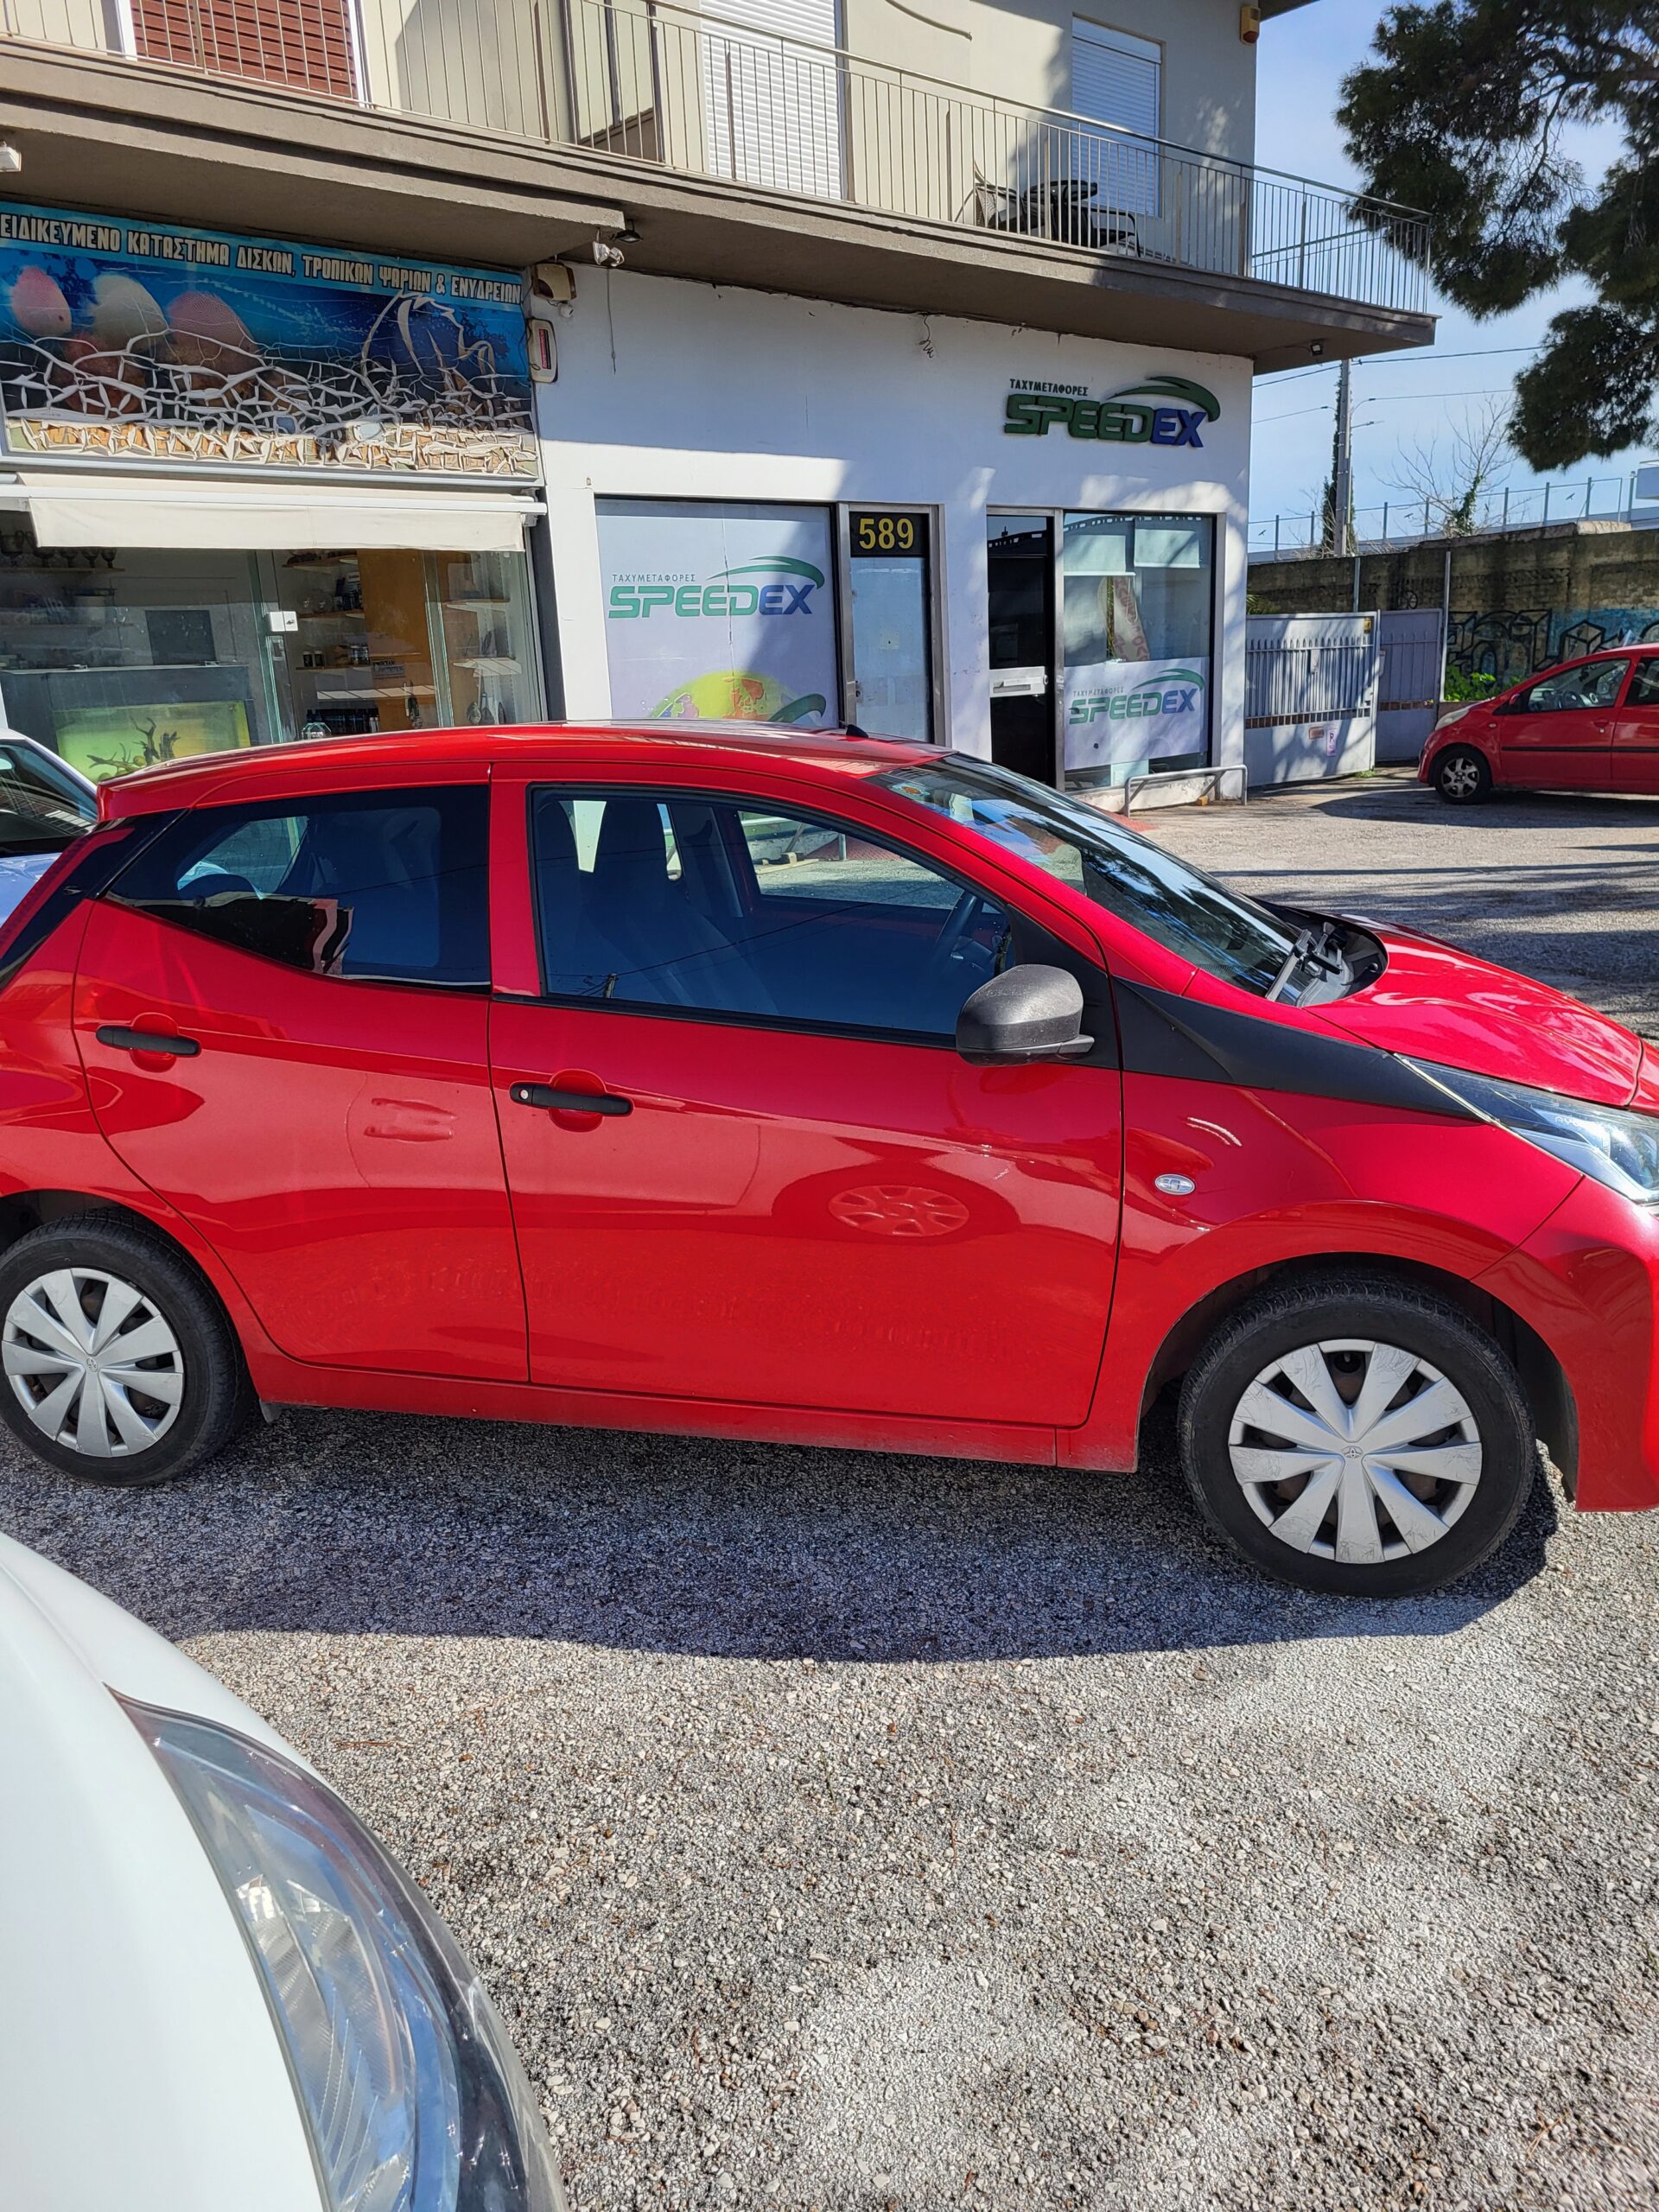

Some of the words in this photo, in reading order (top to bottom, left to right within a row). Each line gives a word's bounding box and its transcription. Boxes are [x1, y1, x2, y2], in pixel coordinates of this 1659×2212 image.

[127, 231, 230, 266] ΚΑΤΑΣΤΗΜΑ
[302, 255, 373, 285] ΤΡΟΠΙΚΩΝ
[378, 265, 431, 293] ΨΑΡΙΩΝ
[435, 274, 446, 295] &
[451, 276, 521, 304] ΕΝΥΔΡΕΙΩΝ
[1009, 378, 1089, 397] ΤΑΧΥΜΕΤΑΦΟΡΕΣ
[1004, 393, 1206, 448] SPEEDEX
[859, 518, 914, 550] 589
[612, 574, 696, 582] ΤΑΧΥΜΕΤΑΦΟΡΕΣ
[608, 584, 815, 619] SPEEDEX
[1068, 688, 1198, 725] SPEEDEX
